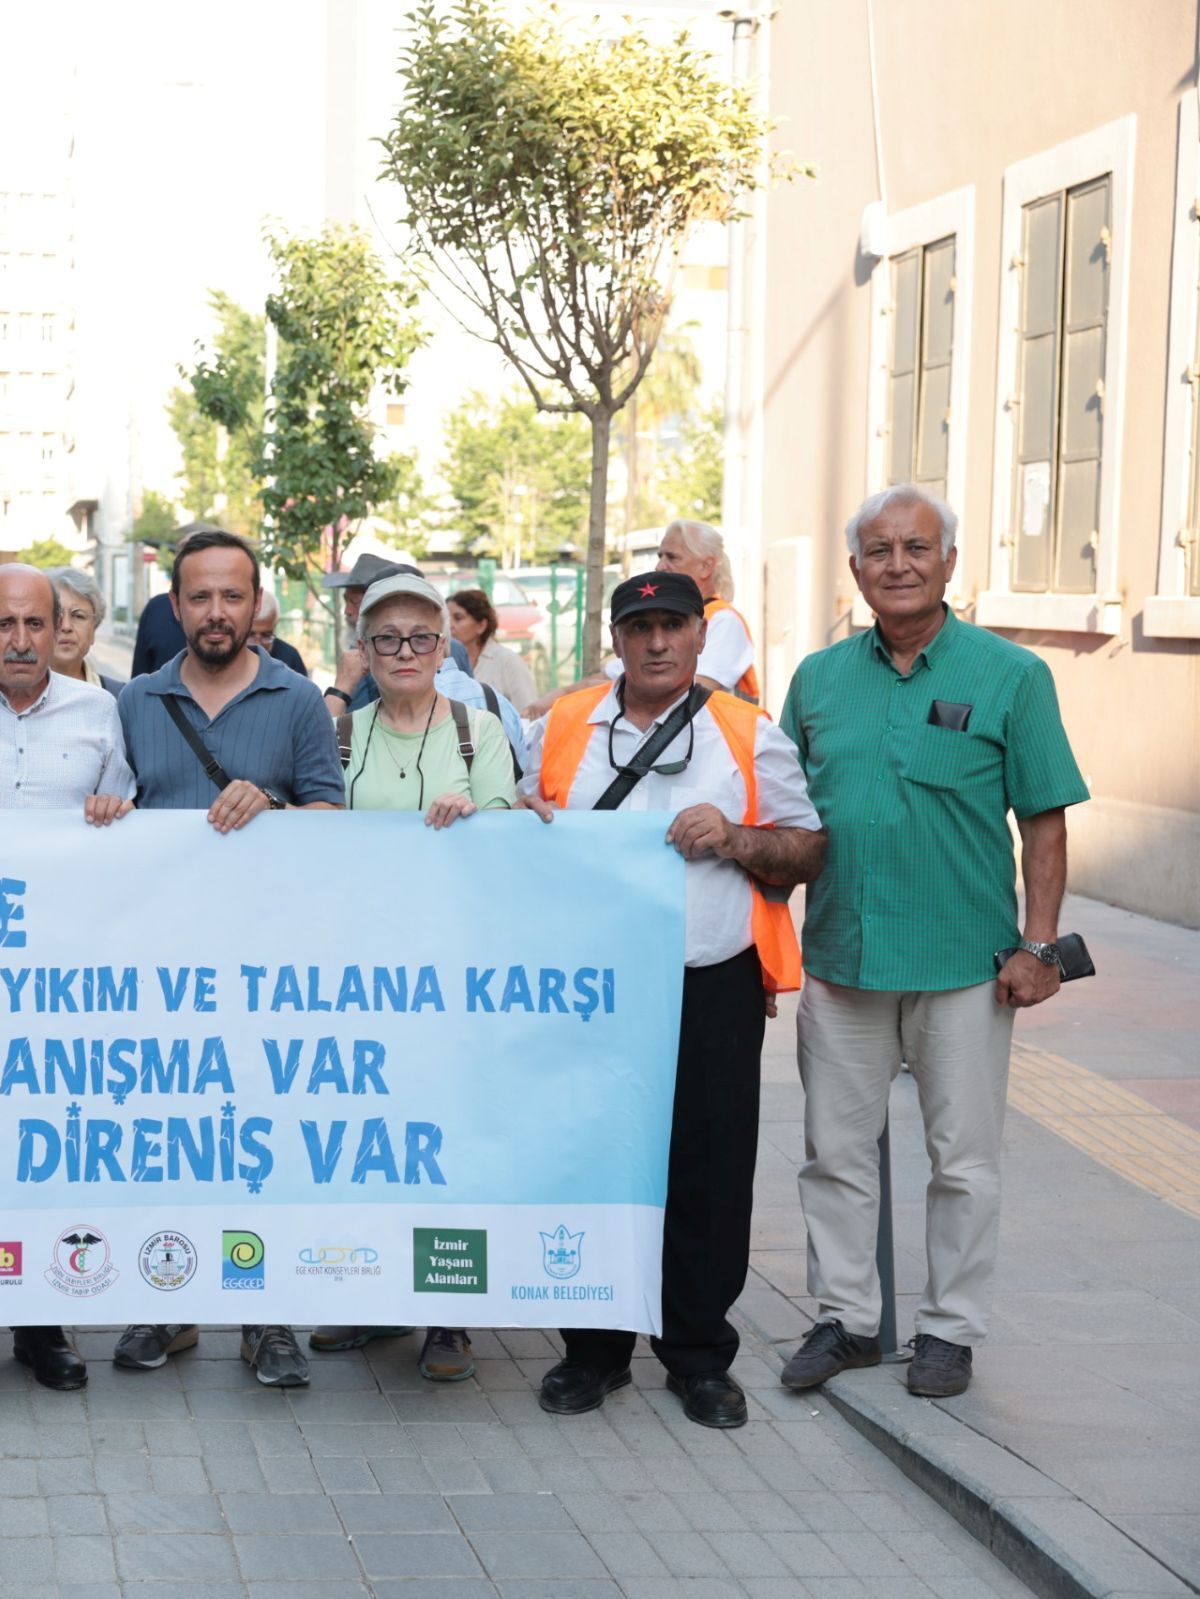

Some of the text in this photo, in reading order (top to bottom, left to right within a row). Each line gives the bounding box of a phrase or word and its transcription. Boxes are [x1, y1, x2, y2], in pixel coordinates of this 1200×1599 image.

[0, 966, 138, 1013] YIKIM
[156, 966, 217, 1013] VE
[240, 964, 446, 1013] TALANA
[466, 964, 615, 1023] KARŞI
[262, 1036, 390, 1095] VAR
[16, 1100, 448, 1195] DİRENİŞ VAR
[164, 1235, 191, 1254] BAROSU
[434, 1237, 469, 1251] İzmir
[429, 1256, 473, 1269] Yaşam
[223, 1278, 264, 1288] EGECEP
[425, 1273, 478, 1286] Alanları
[511, 1284, 614, 1302] KONAK BELEDİYESİ
